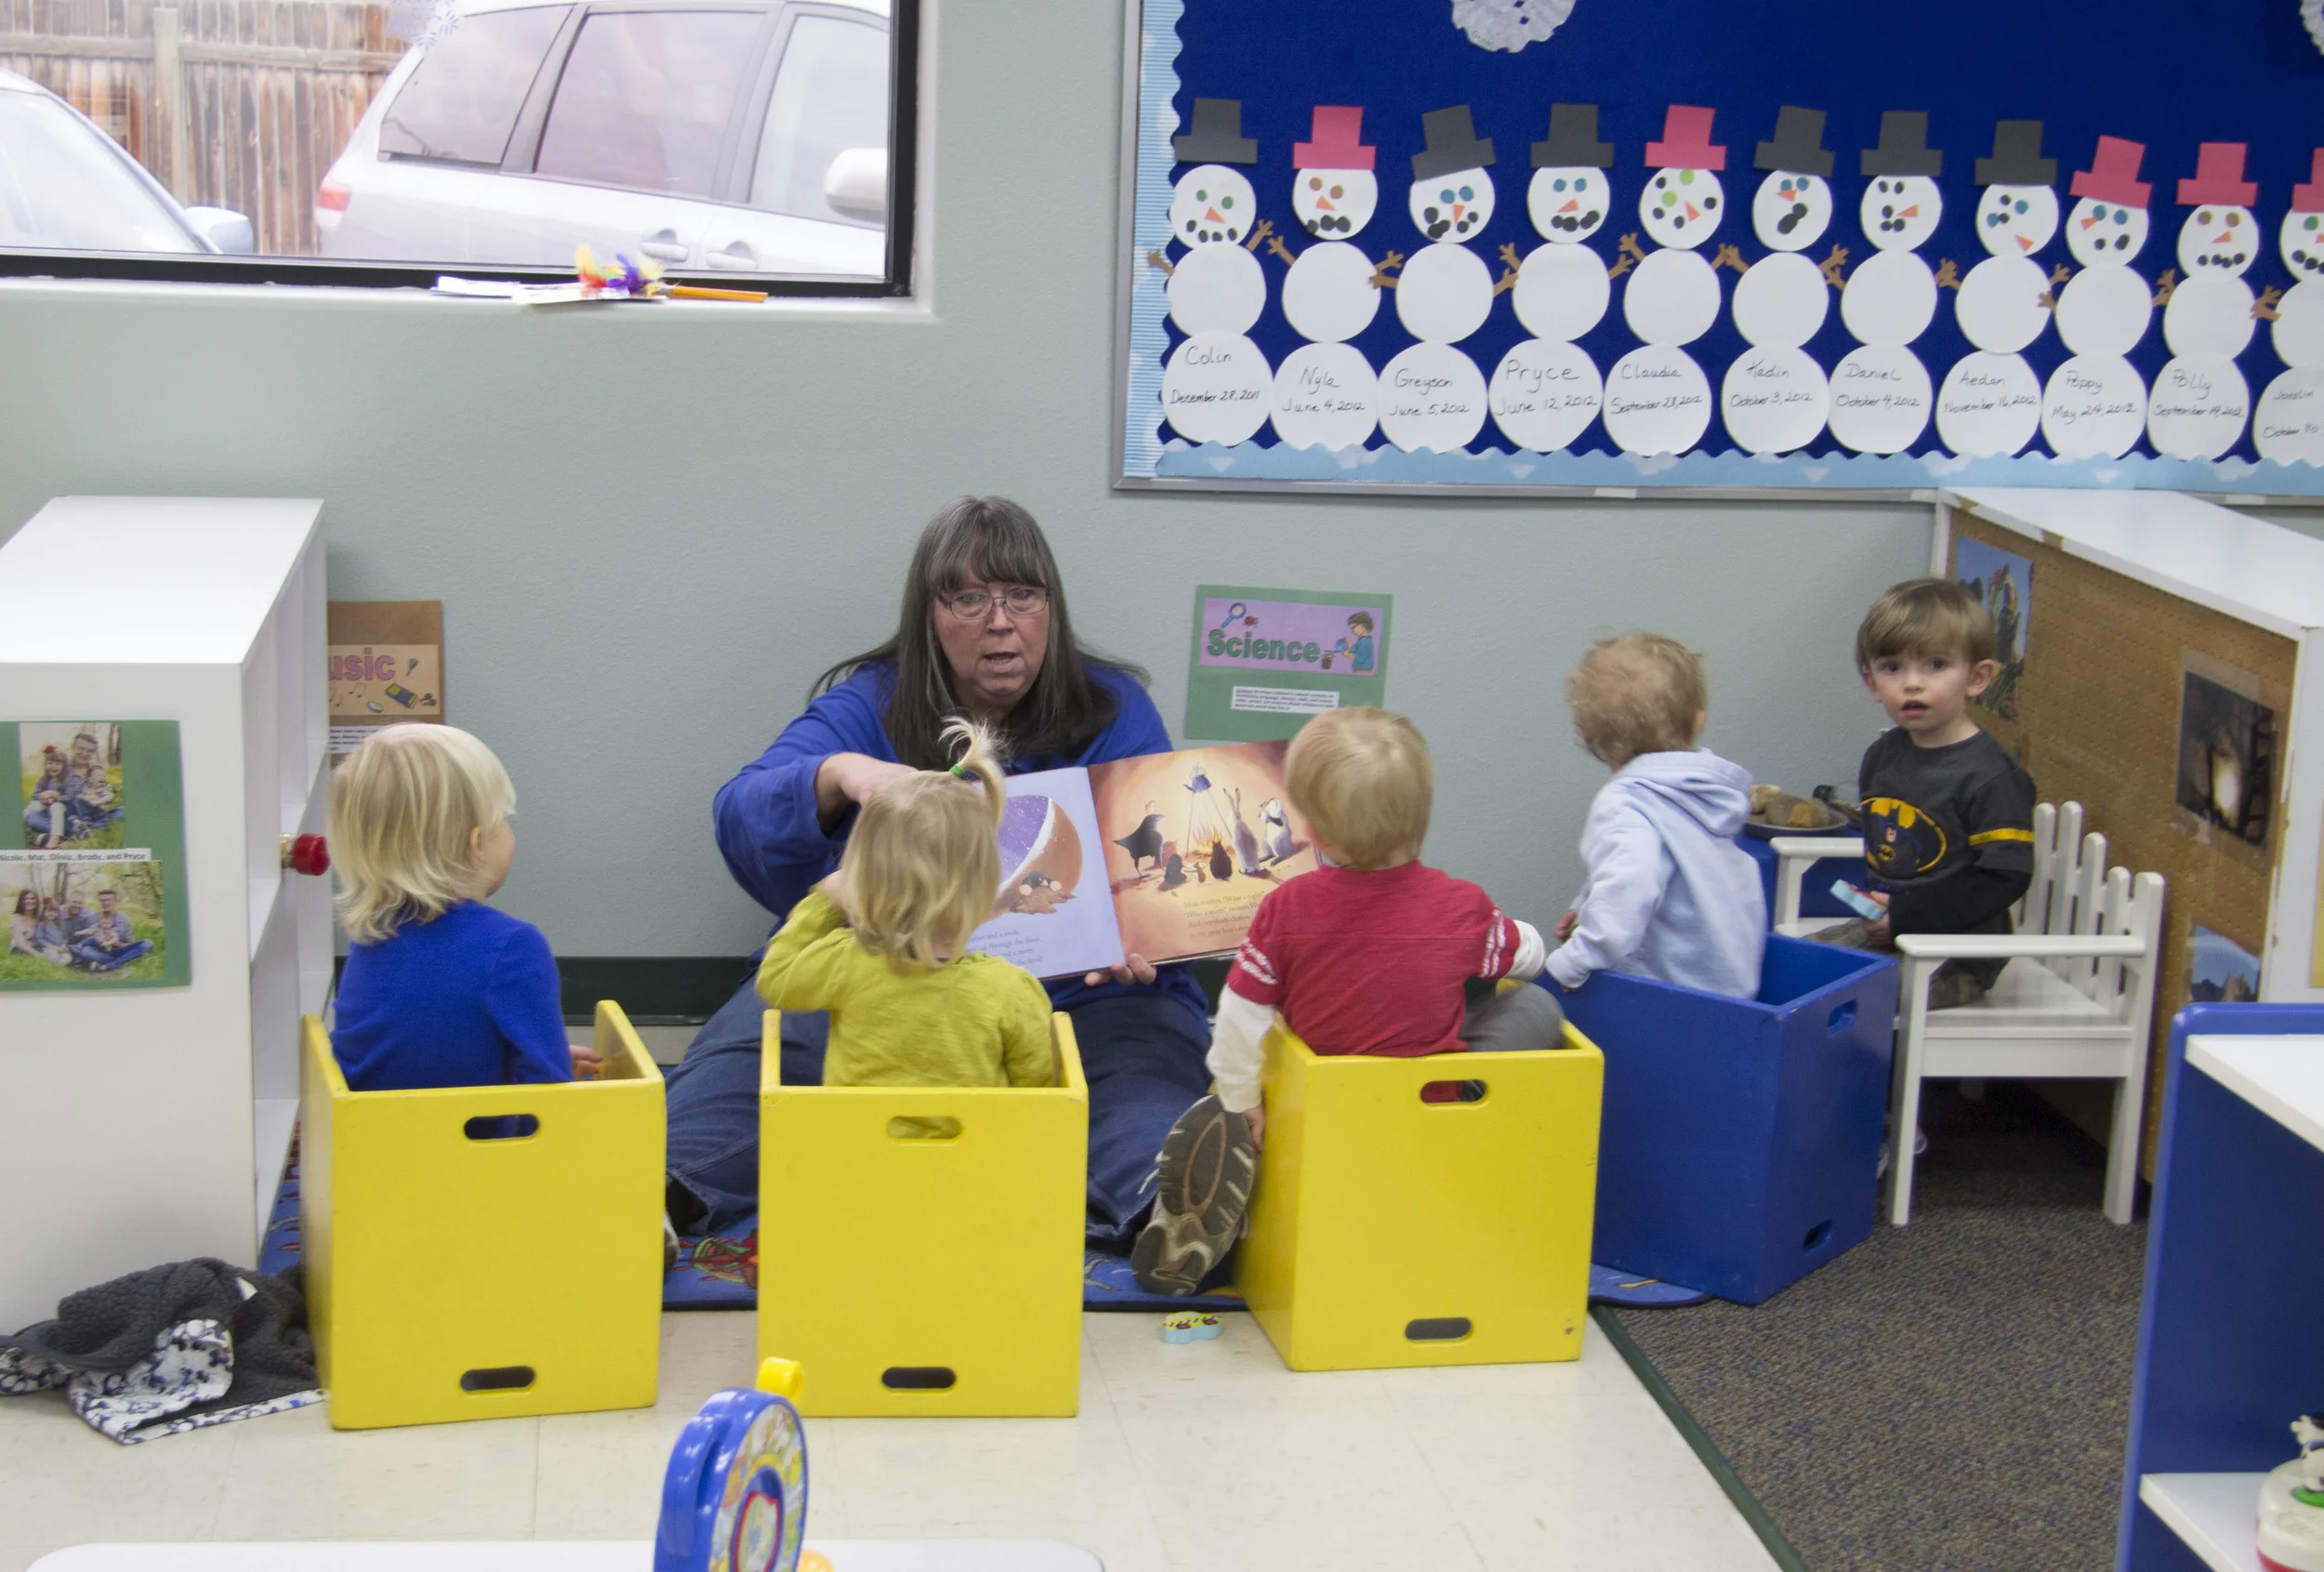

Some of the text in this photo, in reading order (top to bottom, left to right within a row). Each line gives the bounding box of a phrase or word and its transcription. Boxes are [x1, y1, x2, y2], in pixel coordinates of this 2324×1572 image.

[1185, 345, 1233, 365] Colin
[1506, 359, 1580, 393] Pryce
[1747, 358, 1790, 378] Kadin
[1959, 370, 2005, 386] Aedan
[1300, 366, 1341, 395] Nyla
[1394, 367, 1453, 396] Greyson
[2066, 370, 2103, 395] Poppy
[1169, 389, 1217, 404] December
[1282, 398, 1320, 413] June
[1731, 393, 1769, 407] October
[1836, 393, 1881, 407] October
[1942, 398, 1995, 414] November
[1389, 404, 1422, 416] June
[1496, 398, 1536, 416] June
[2051, 404, 2077, 425] May
[1207, 628, 1321, 663] Science
[328, 647, 395, 680] usic
